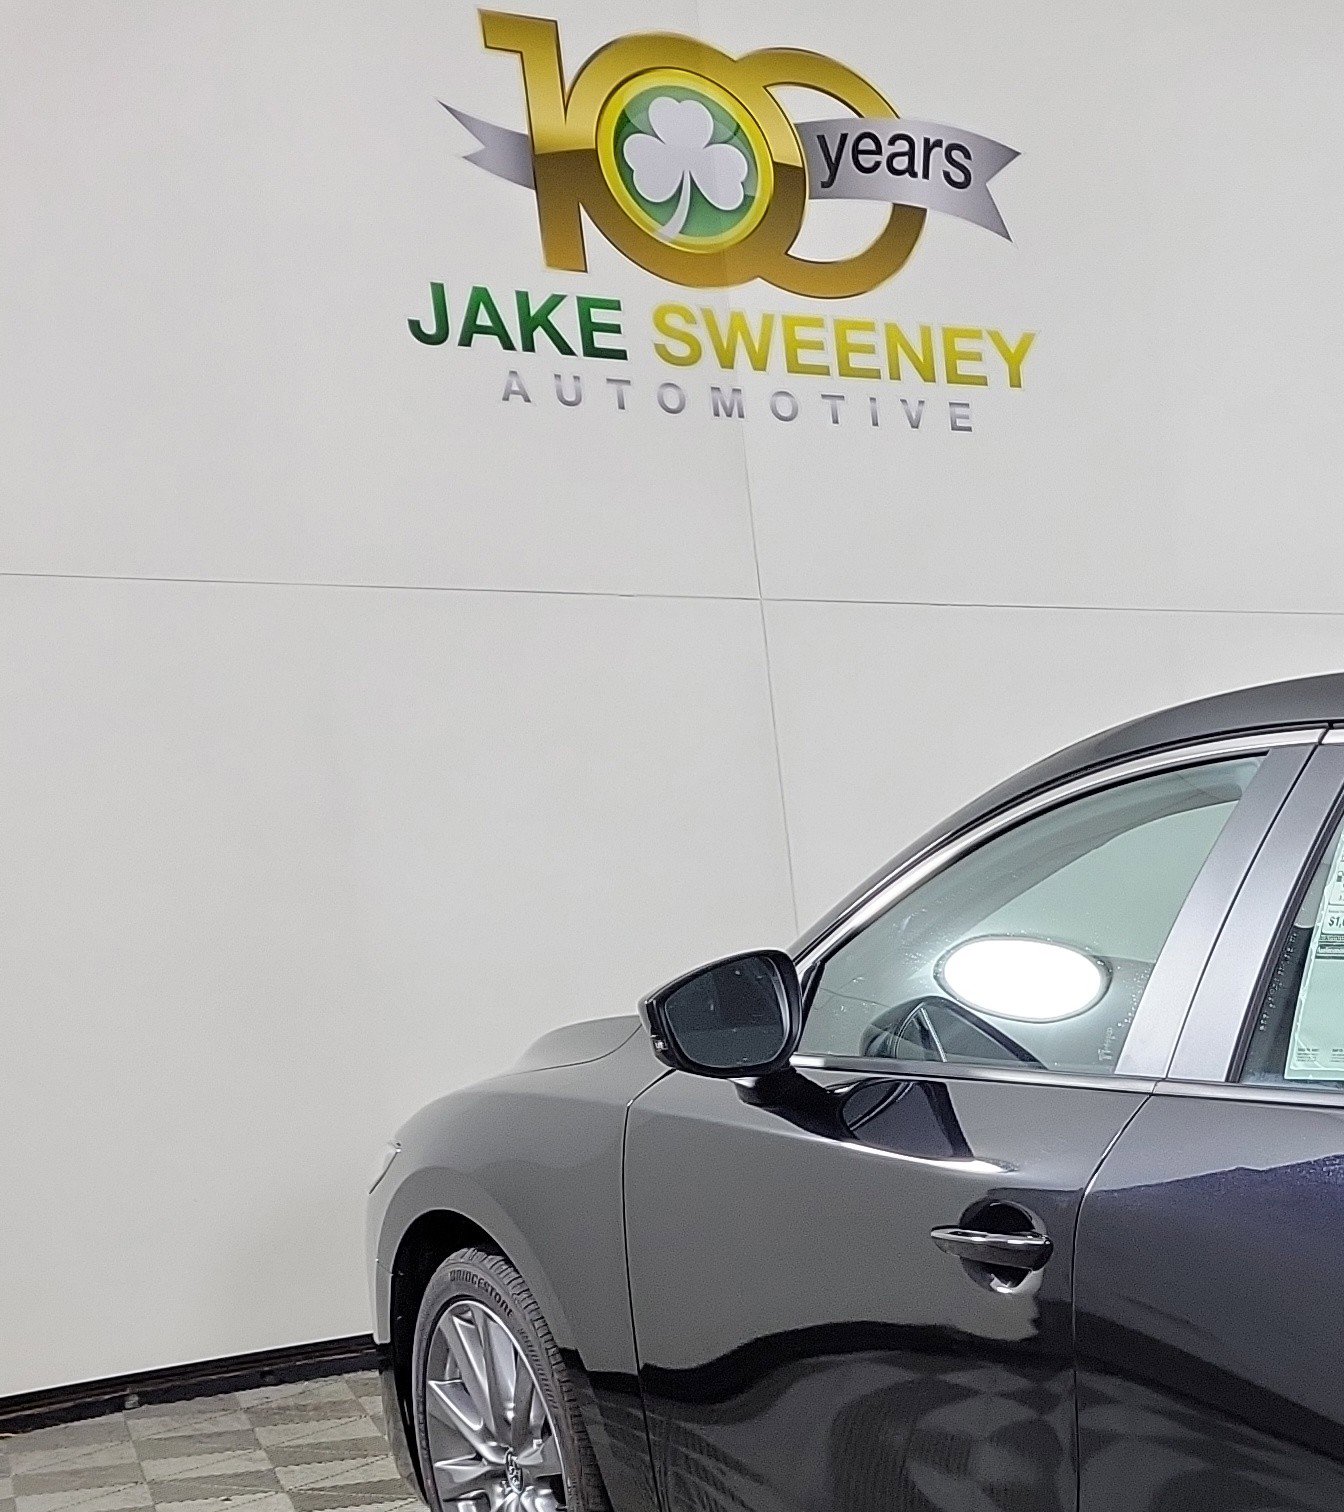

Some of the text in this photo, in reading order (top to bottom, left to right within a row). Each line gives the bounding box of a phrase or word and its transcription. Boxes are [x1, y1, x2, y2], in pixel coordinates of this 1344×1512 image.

[477, 8, 974, 299] 100 years
[407, 281, 1035, 389] JAKE SWEENEY
[501, 370, 974, 432] AUTOMOTIVE
